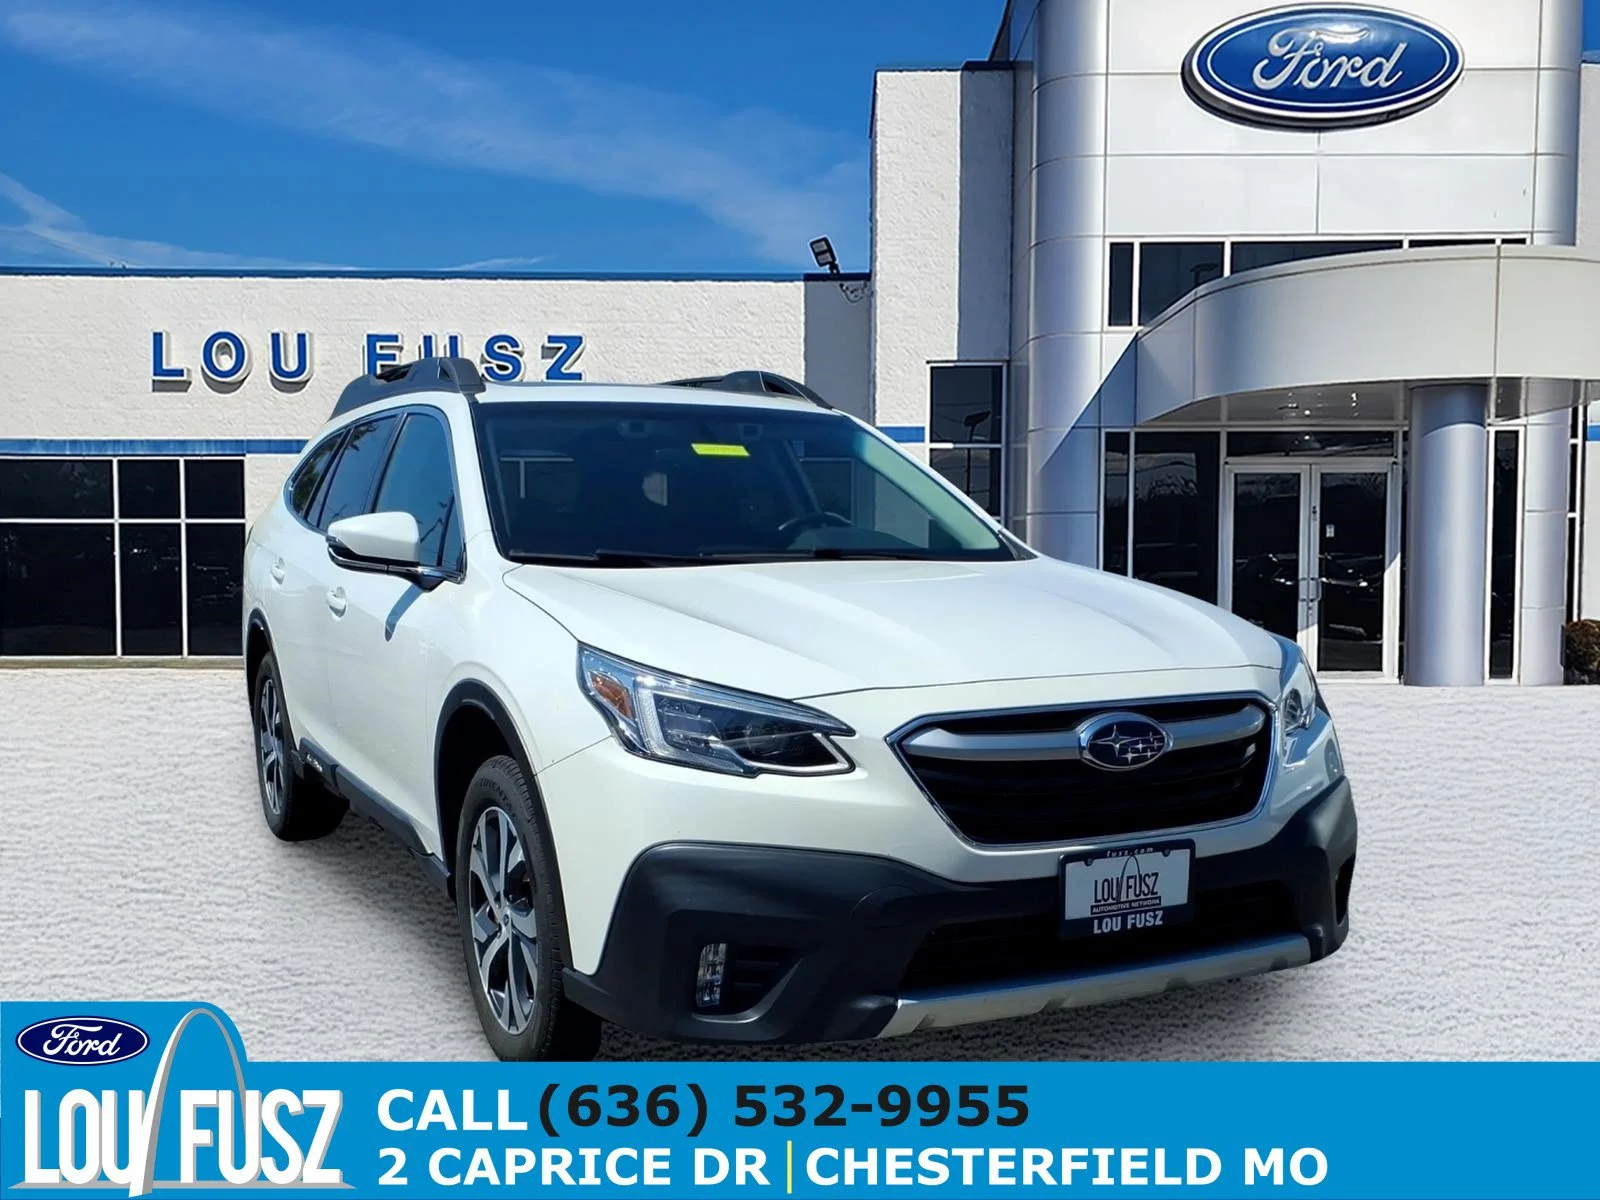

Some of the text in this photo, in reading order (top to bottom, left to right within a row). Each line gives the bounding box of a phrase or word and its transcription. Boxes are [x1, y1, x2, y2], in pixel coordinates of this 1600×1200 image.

[1252, 26, 1407, 90] Ford
[152, 331, 308, 379] LOU
[1094, 872, 1160, 904] LOU FUSZ
[1092, 898, 1160, 914] AUTOMOTIVE NETWORK
[1094, 910, 1163, 934] LOU FUSZ
